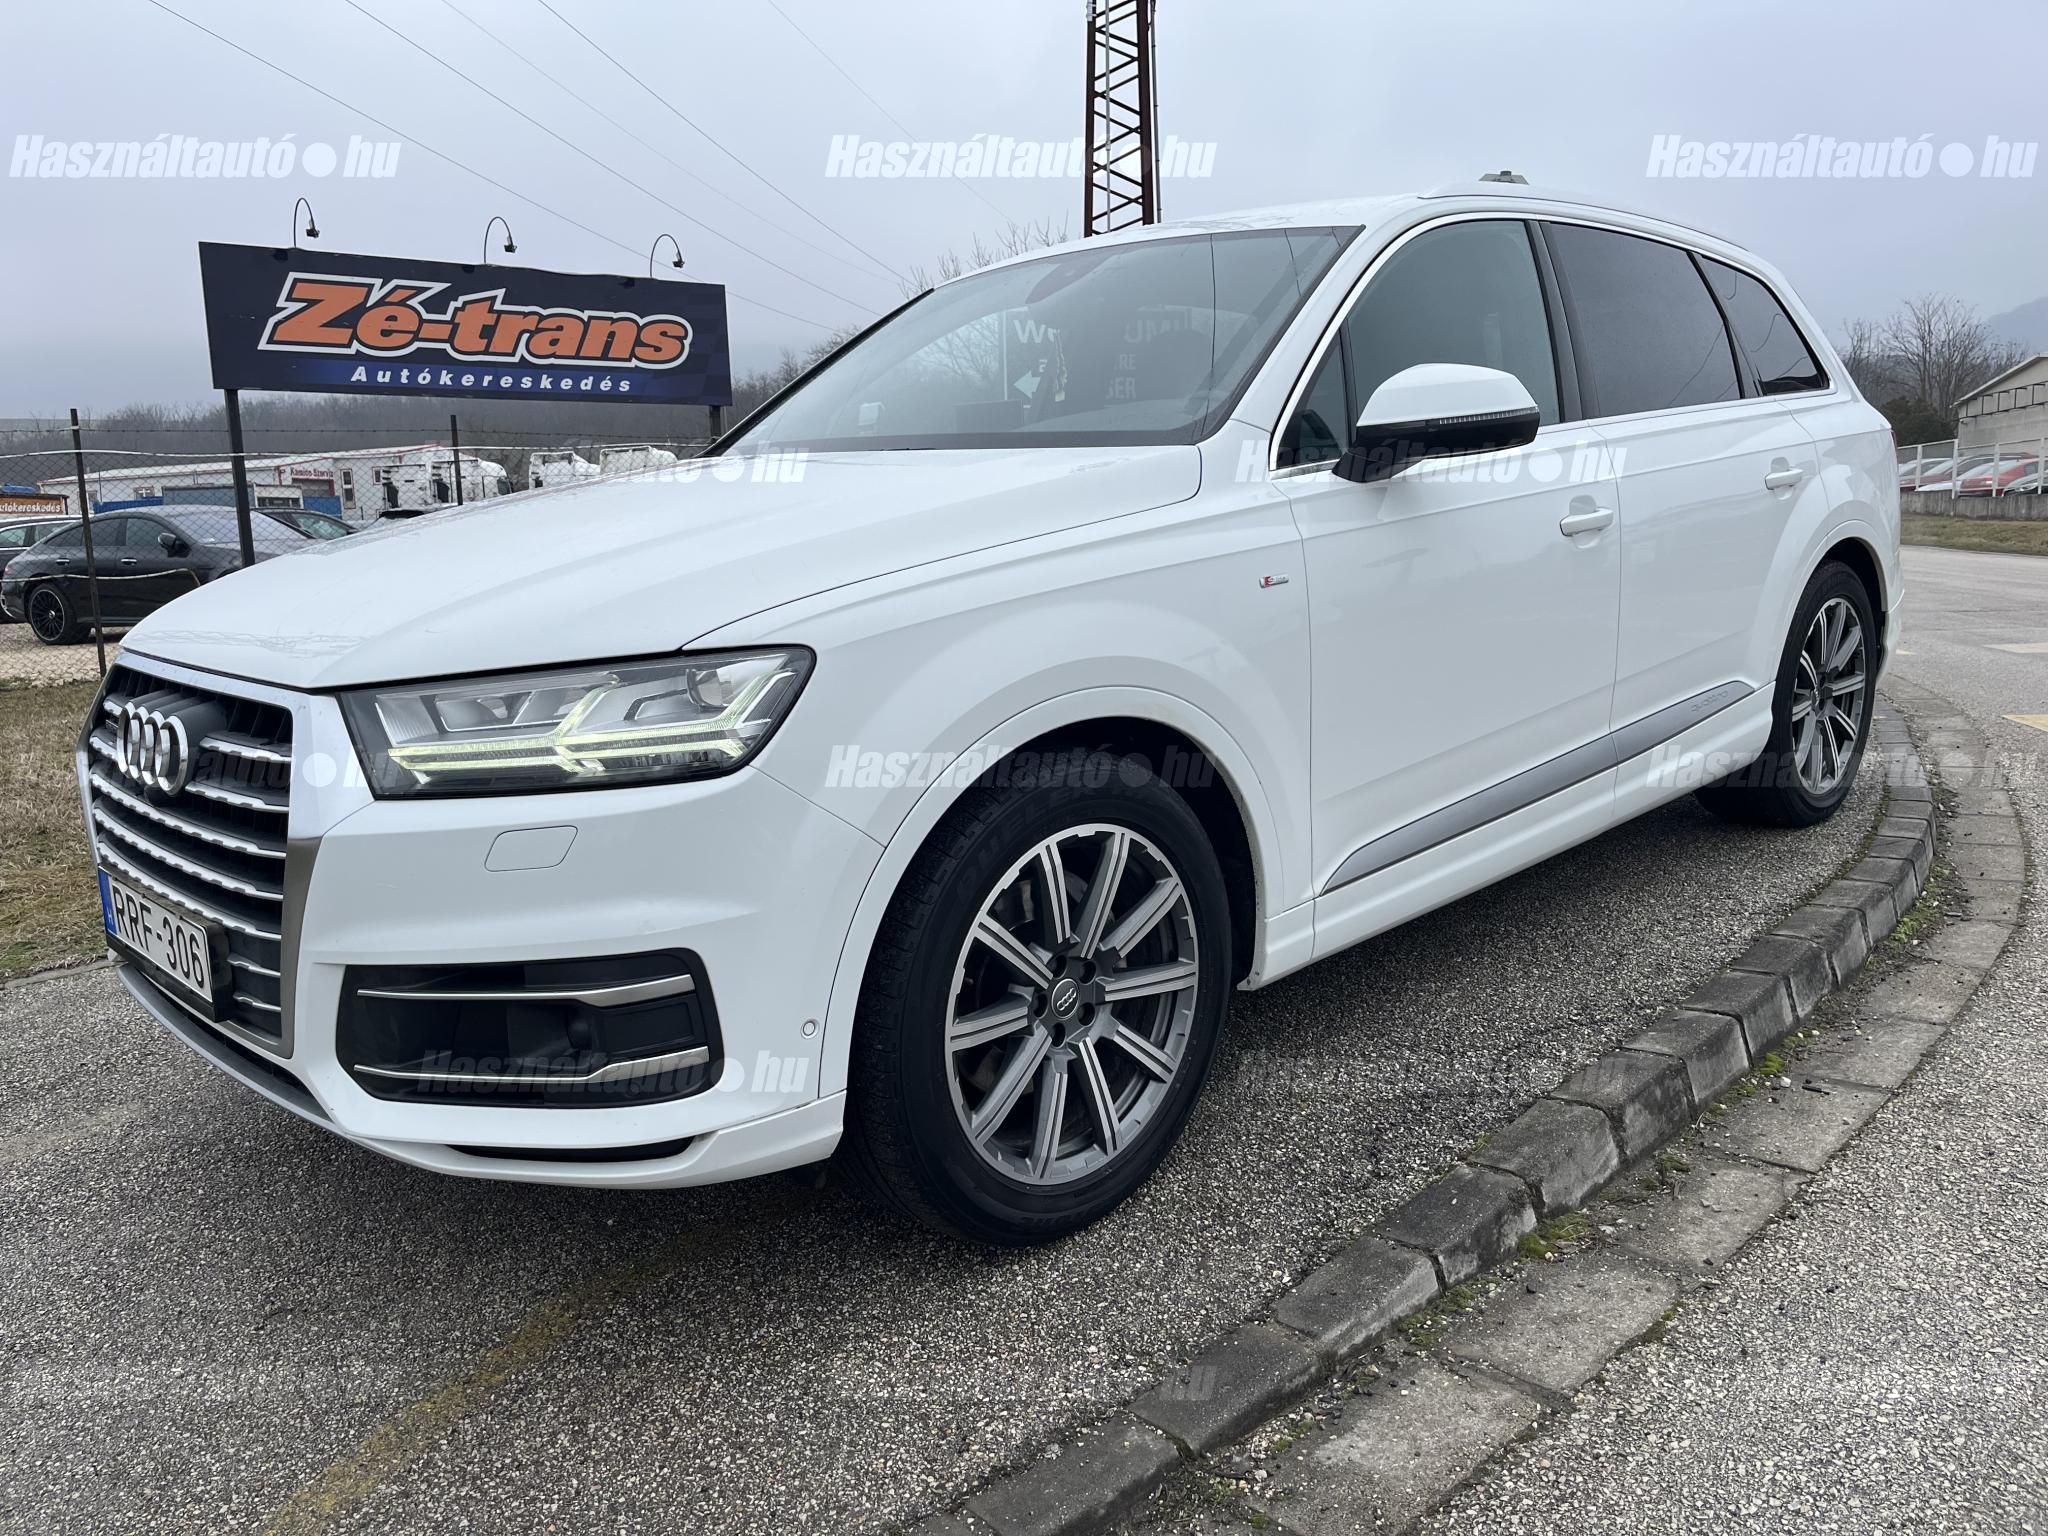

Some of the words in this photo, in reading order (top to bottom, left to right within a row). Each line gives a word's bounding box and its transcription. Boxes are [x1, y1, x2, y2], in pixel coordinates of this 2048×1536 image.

[260, 273, 691, 367] Zé-trans
[350, 365, 632, 392] Autókereskedés
[112, 884, 205, 989] RRF-306
